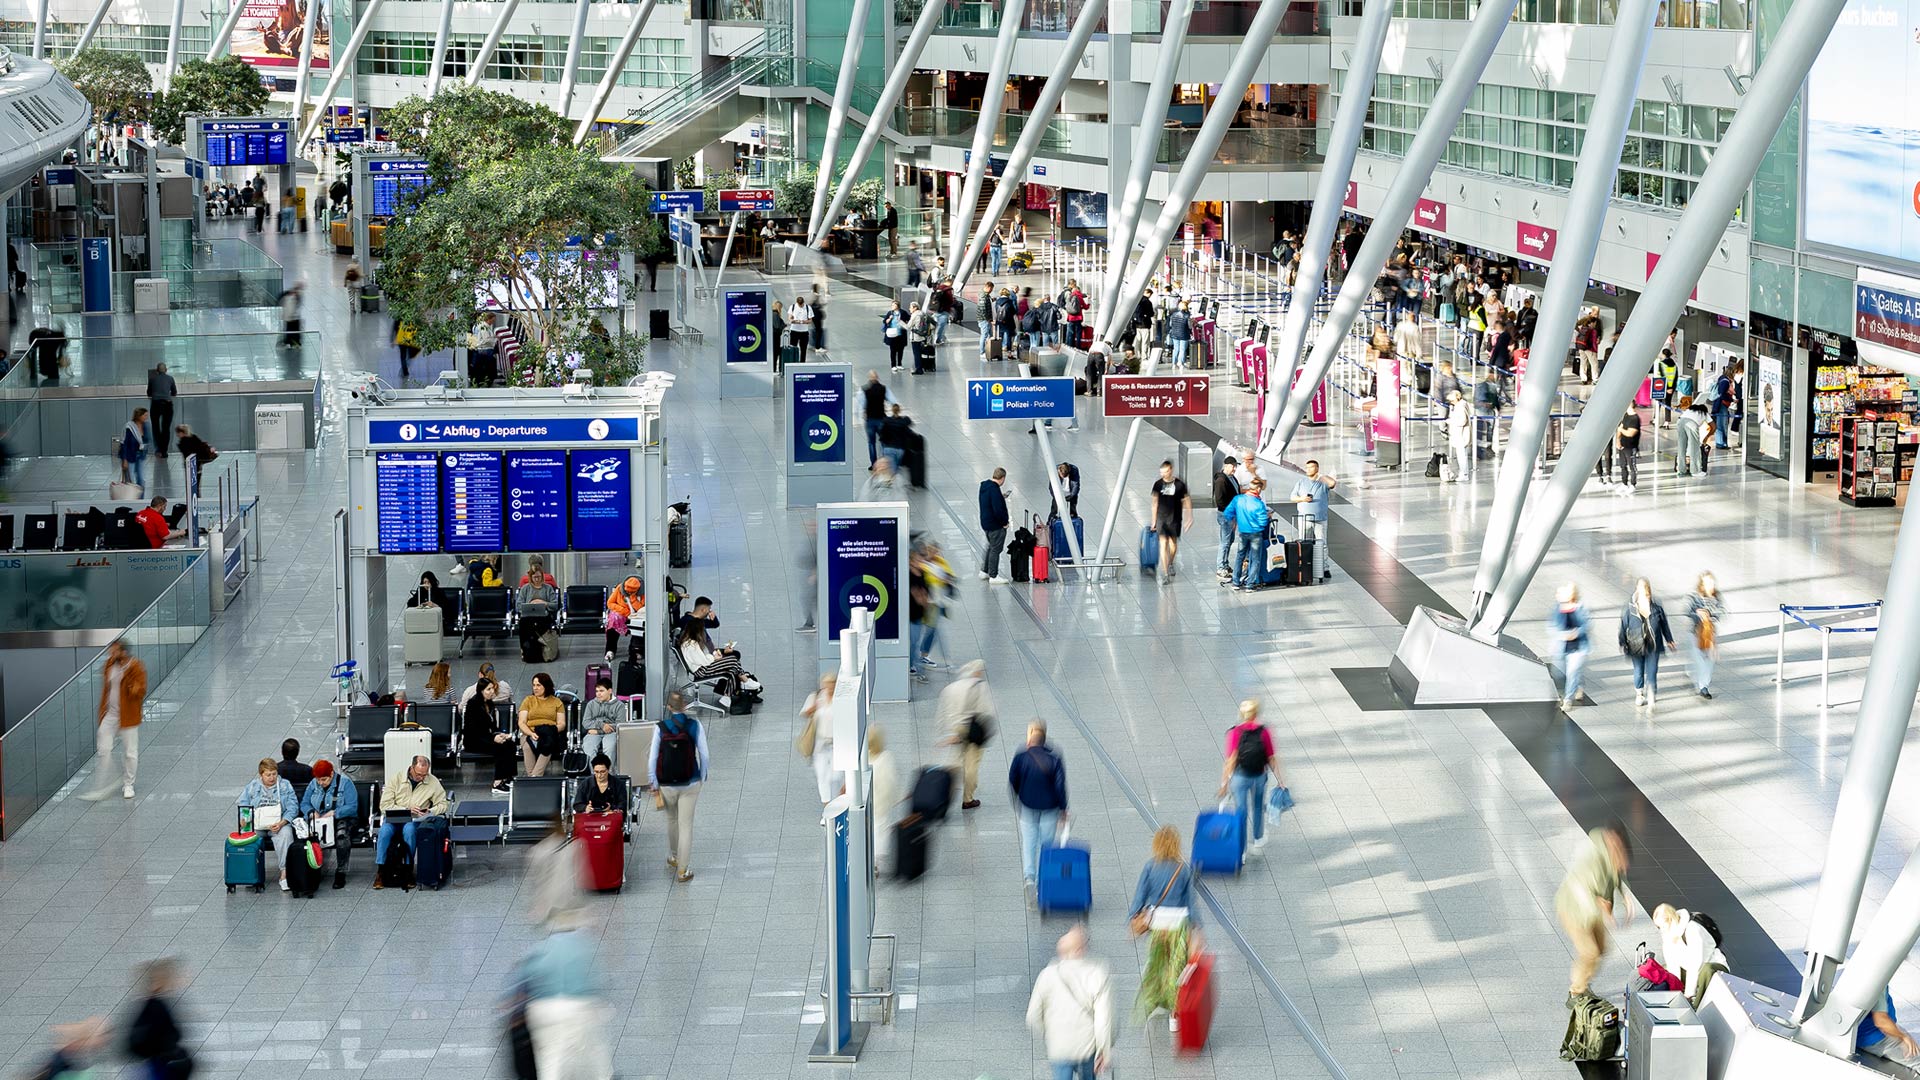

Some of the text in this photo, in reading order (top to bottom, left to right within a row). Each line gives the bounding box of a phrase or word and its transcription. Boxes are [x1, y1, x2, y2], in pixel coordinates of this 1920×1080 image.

[1861, 4, 1898, 26] buchen
[1524, 234, 1544, 251] Eurowings
[91, 251, 99, 259] B
[1878, 294, 1903, 314] Gates
[1814, 330, 1840, 349] WHSmith
[1877, 322, 1920, 343] Shops & Restau
[443, 425, 547, 438] Abflug Departures
[849, 594, 879, 603] 59 %
